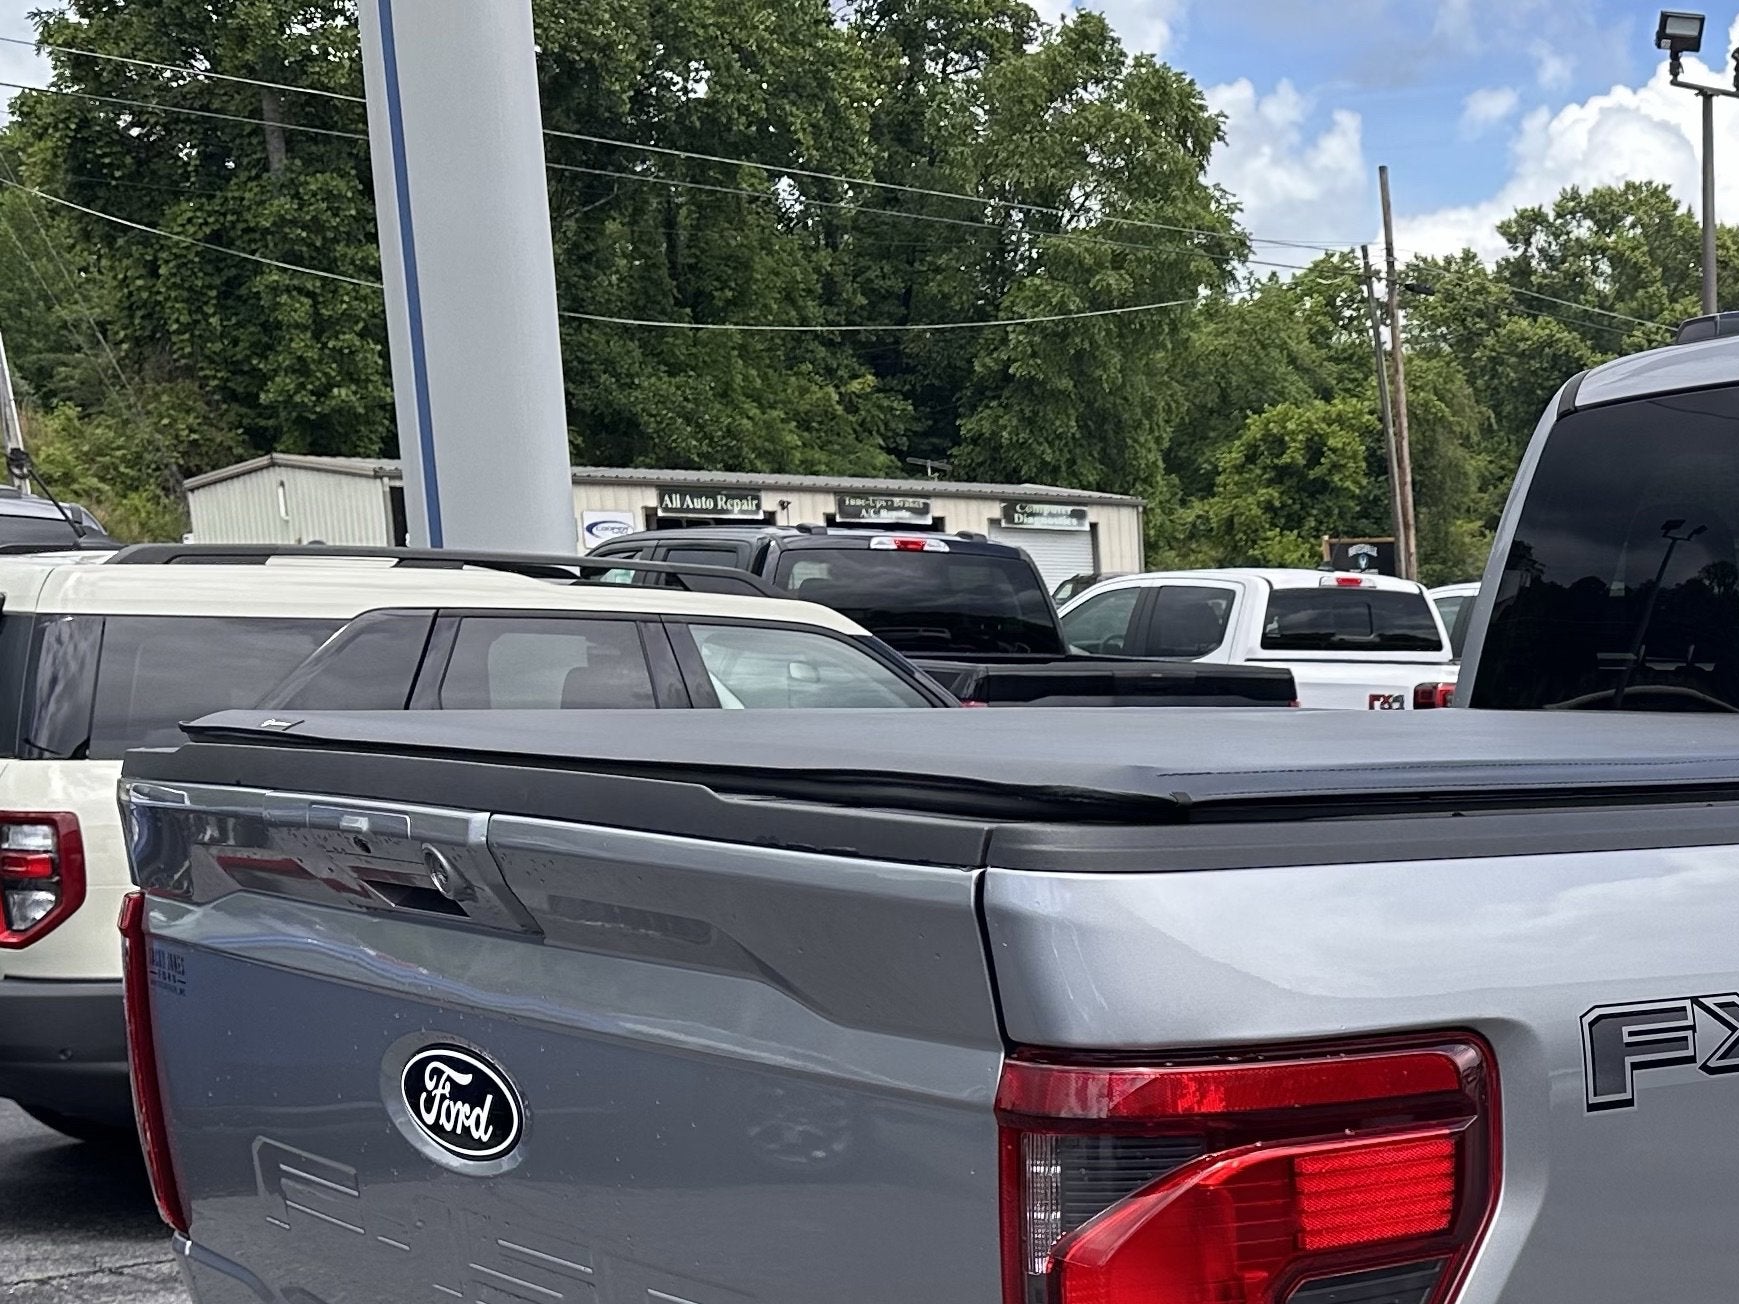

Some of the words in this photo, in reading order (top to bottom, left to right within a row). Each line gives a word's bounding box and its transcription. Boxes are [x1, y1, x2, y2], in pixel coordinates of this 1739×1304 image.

[661, 493, 681, 509] All
[683, 494, 714, 510] Auto
[716, 494, 758, 513] Repair
[420, 1061, 494, 1142] Ford
